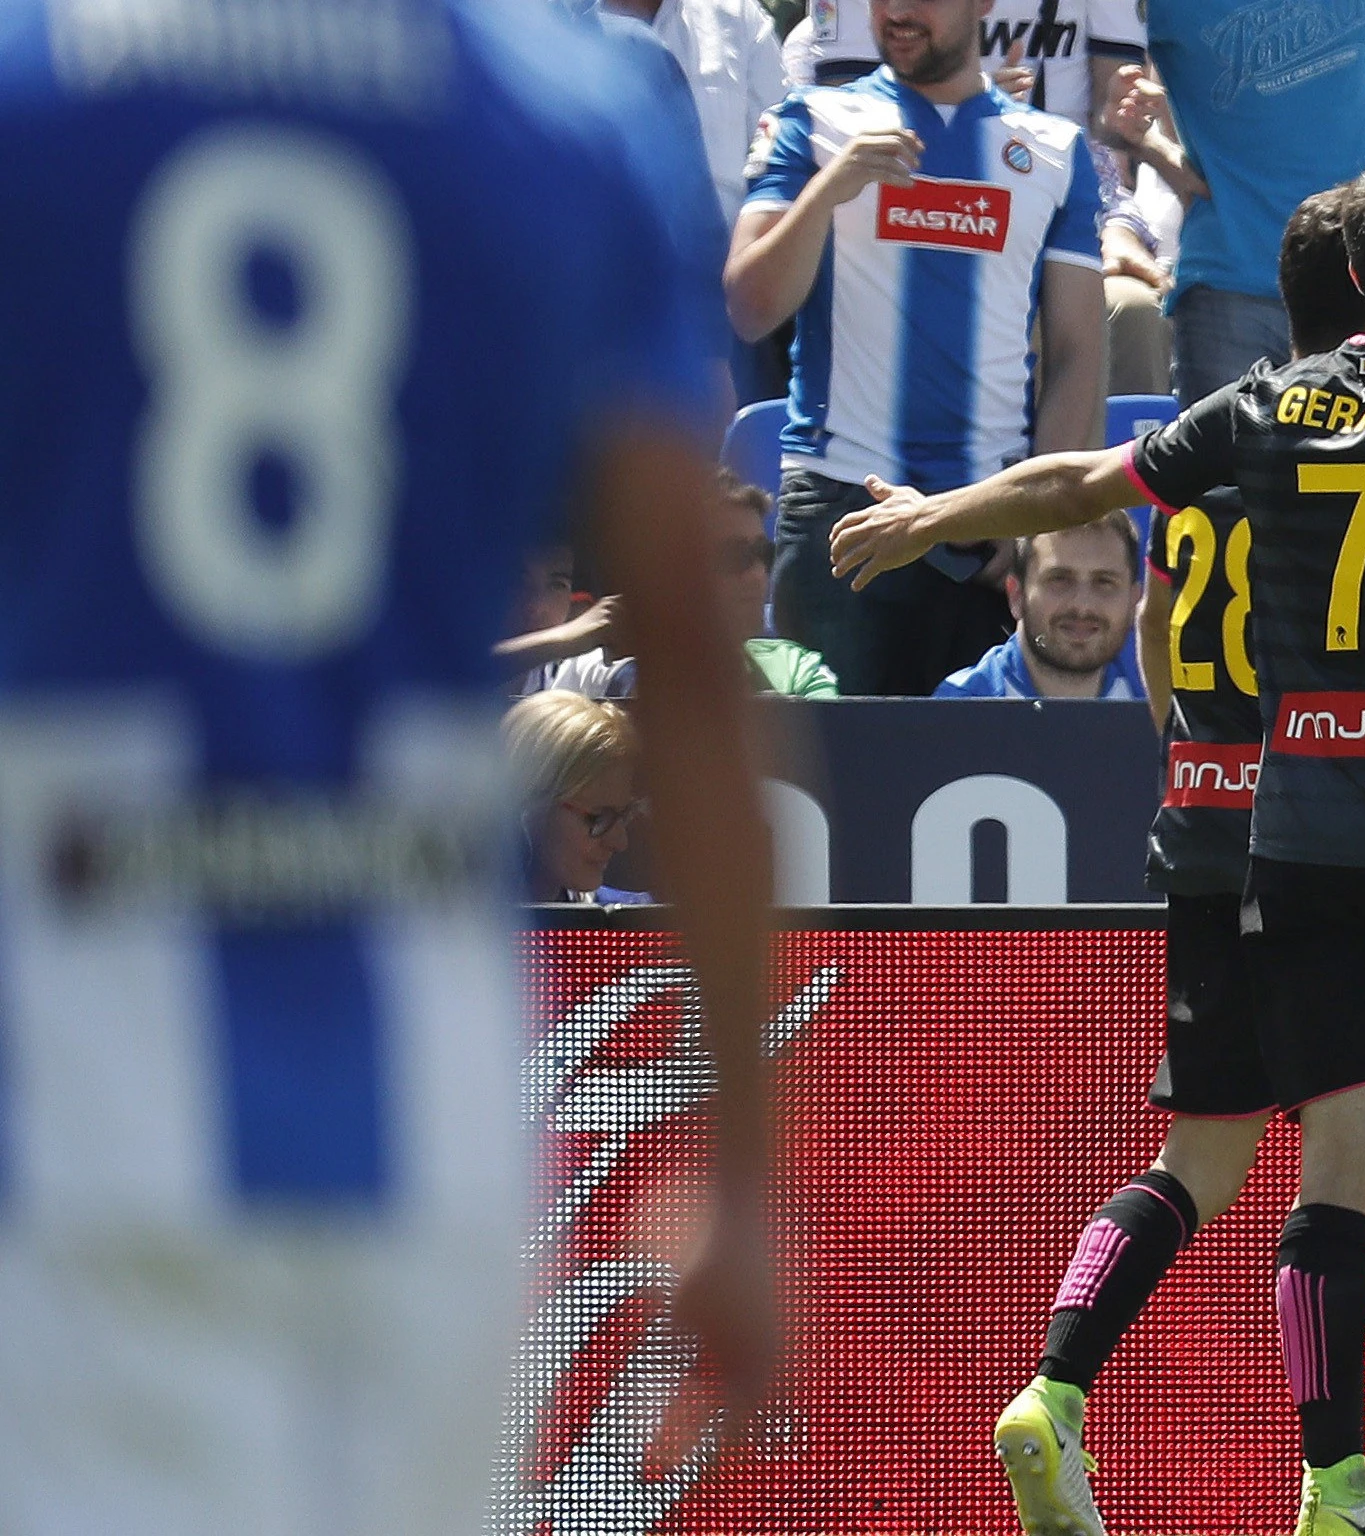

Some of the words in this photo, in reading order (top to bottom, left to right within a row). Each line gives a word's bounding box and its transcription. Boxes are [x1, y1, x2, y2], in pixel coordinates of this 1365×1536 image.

[886, 206, 999, 237] RASTAR
[128, 122, 415, 660] 8
[1166, 506, 1259, 696] 28
